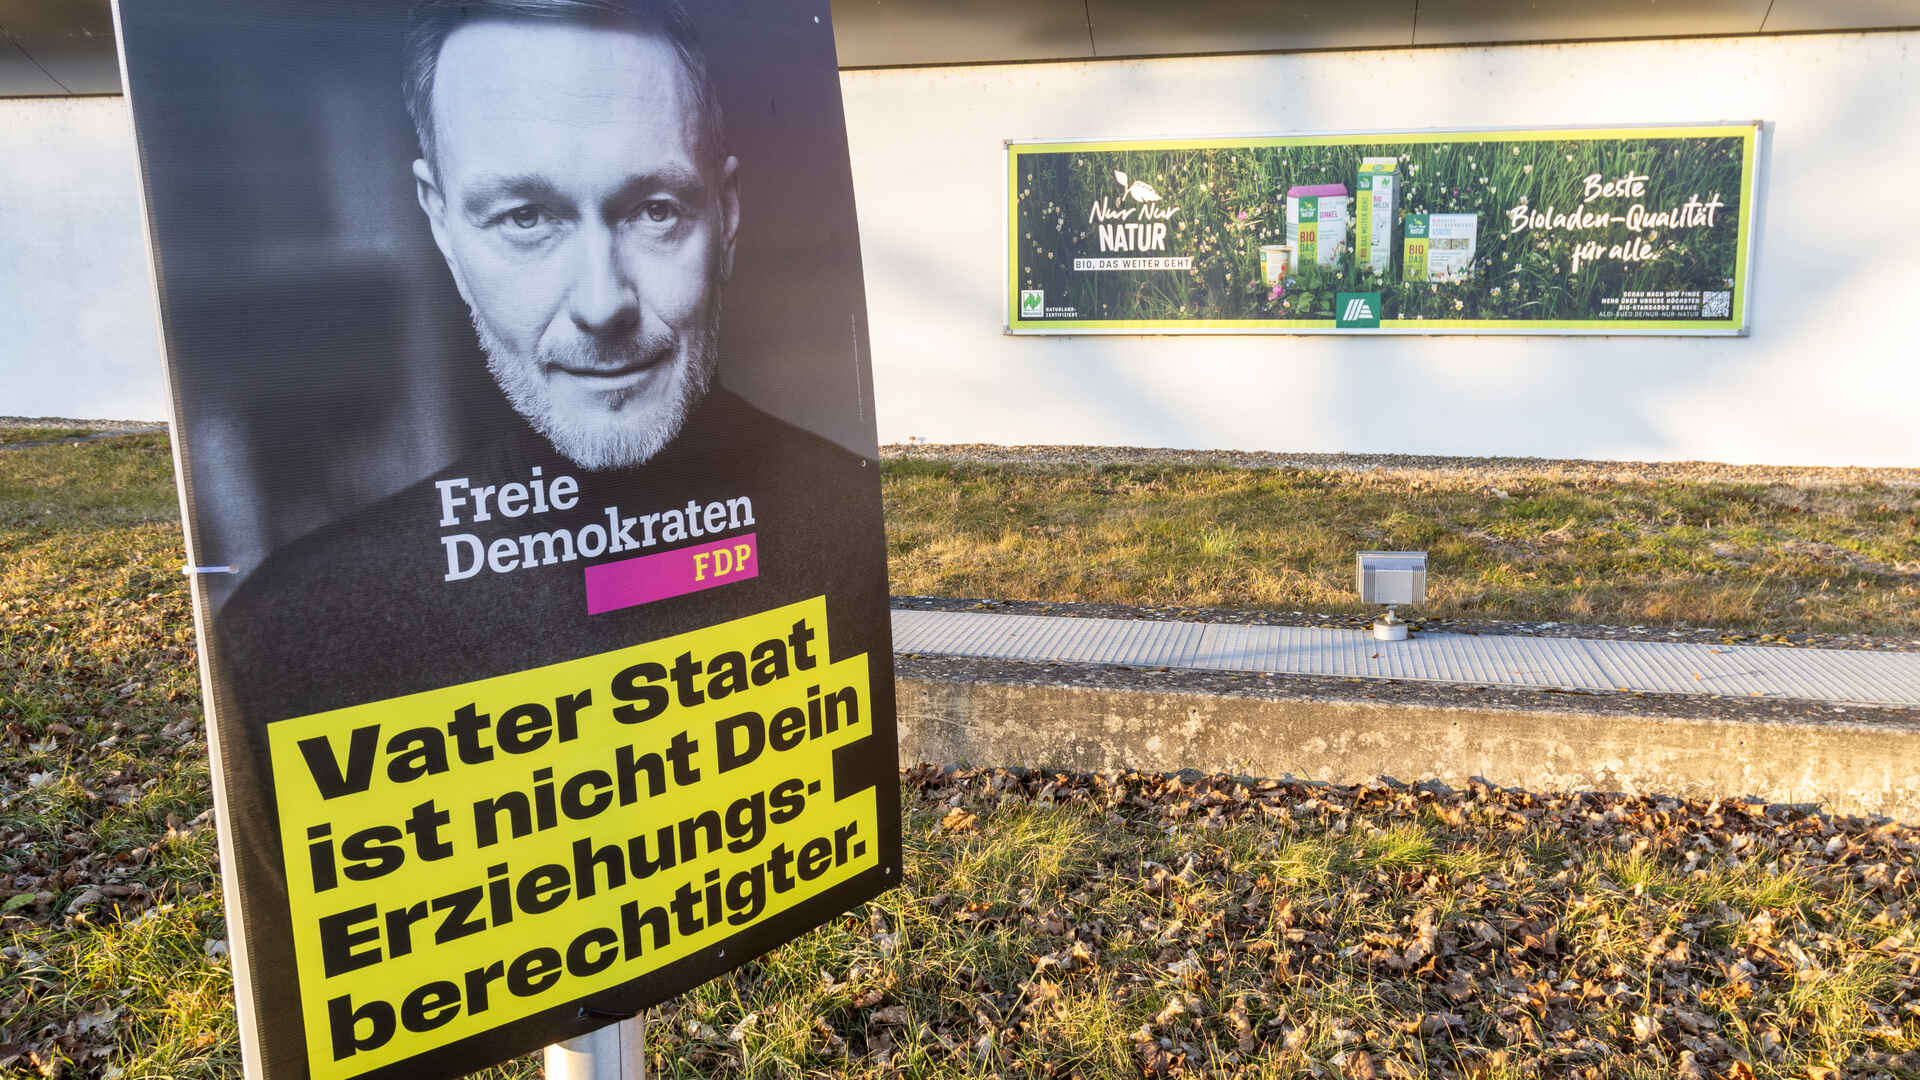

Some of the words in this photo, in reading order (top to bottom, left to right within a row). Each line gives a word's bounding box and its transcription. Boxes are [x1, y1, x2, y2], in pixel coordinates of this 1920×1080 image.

[1583, 170, 1649, 202] Beste
[1088, 195, 1137, 224] Nur
[1137, 202, 1181, 221] Nur
[1511, 193, 1725, 233] Bioladen-Qualität
[1098, 222, 1167, 252] NATUR
[1300, 231, 1315, 242] BIO
[1409, 244, 1424, 255] BIO
[1571, 242, 1607, 273] für
[1608, 237, 1658, 261] alle.
[1075, 260, 1095, 269] BIO,
[1099, 260, 1119, 268] DAS
[1122, 259, 1160, 268] WEITER
[1164, 258, 1189, 267] GEHT
[435, 466, 579, 527] Freie
[441, 495, 756, 582] Demokraten
[693, 544, 752, 582] FDP
[297, 688, 593, 800] Vater
[611, 618, 817, 724] Staat
[307, 800, 454, 893] ist
[474, 731, 701, 849] nicht
[716, 685, 859, 774] Dein
[319, 779, 822, 979] Erziehungs-
[328, 819, 867, 1061] berechtigter.
